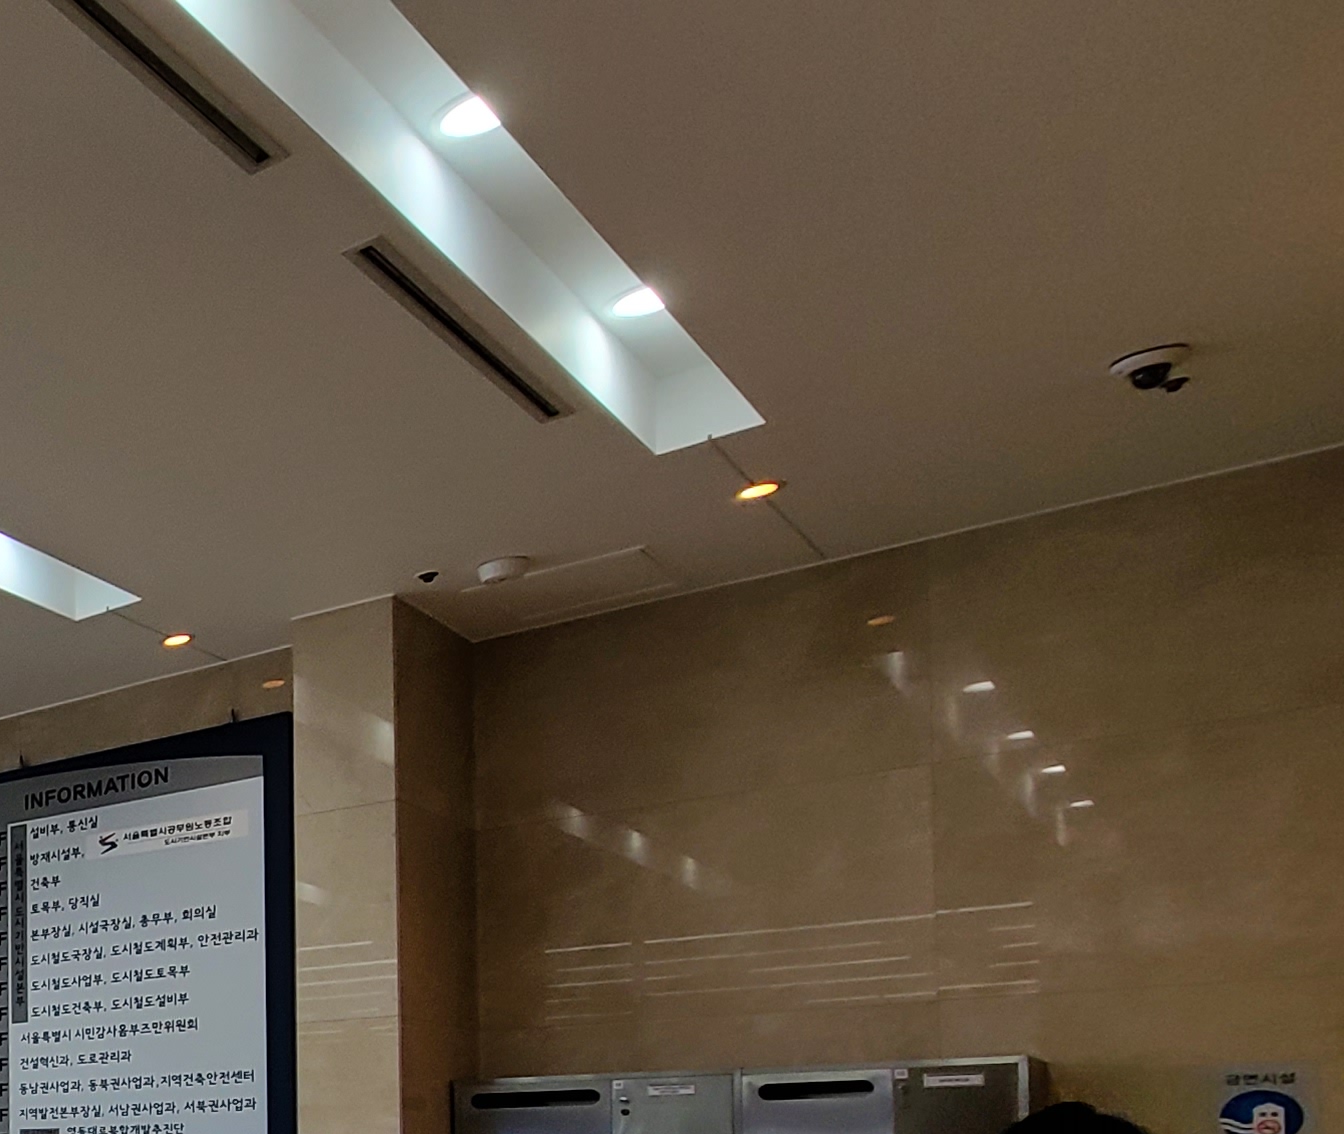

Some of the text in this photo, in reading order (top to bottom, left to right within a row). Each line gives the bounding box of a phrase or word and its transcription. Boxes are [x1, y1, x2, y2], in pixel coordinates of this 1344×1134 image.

[24, 766, 169, 811] INFORMATION
[67, 815, 98, 833] 통신실
[30, 875, 61, 891] 건축부
[68, 893, 100, 910] 당직실
[182, 904, 217, 921] 회의실
[197, 928, 260, 948] 안전관리과
[110, 964, 191, 984] 도시철도토목부
[110, 992, 190, 1011] 도시철도설비부
[20, 1029, 72, 1045] 서울특별시
[76, 1050, 132, 1065] 도로관리과
[184, 1097, 257, 1115] 서북권사업과
